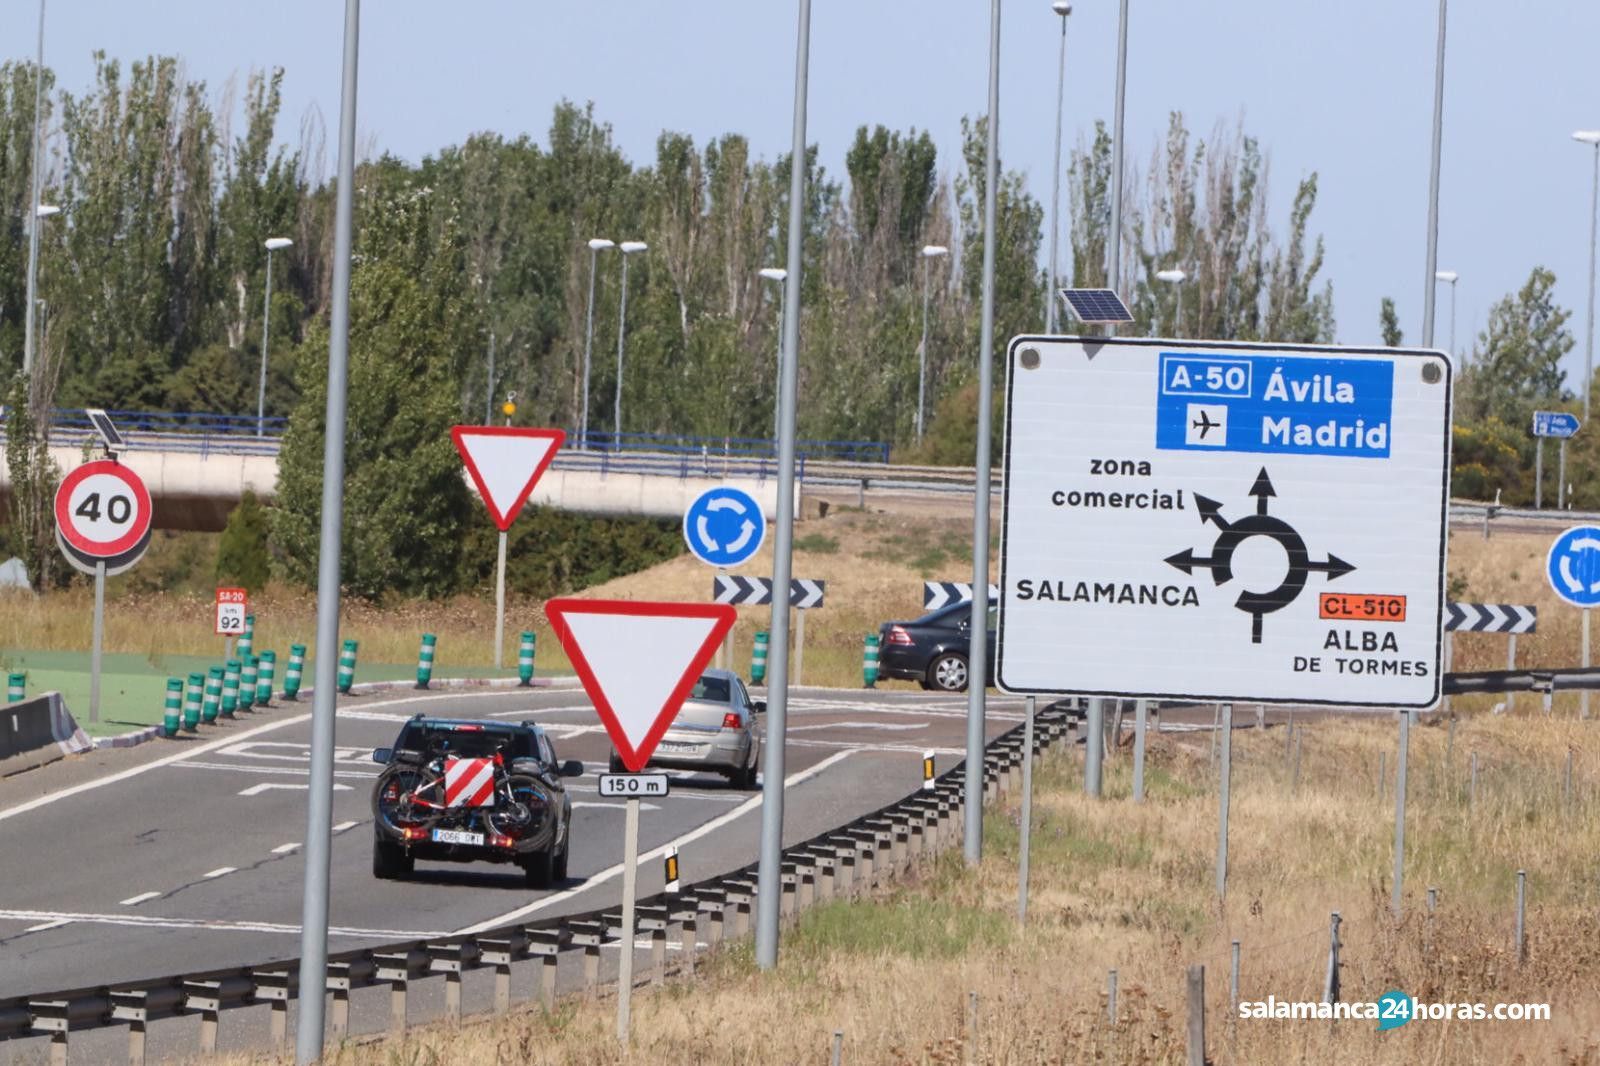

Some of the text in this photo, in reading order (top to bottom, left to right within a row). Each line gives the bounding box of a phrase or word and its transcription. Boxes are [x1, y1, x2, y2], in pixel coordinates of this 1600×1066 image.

[1170, 366, 1245, 390] A-50
[1264, 367, 1355, 403] Ávila
[1262, 417, 1387, 448] Madrid
[1090, 459, 1152, 476] zona
[76, 493, 131, 524] 40
[1052, 489, 1184, 510] comercial
[1016, 580, 1199, 606] SALAMANCA
[1324, 598, 1401, 617] CL-510
[221, 616, 240, 629] 92
[1323, 631, 1398, 652] ALBA
[1294, 657, 1428, 676] DE TORMES
[608, 779, 659, 792] 150 m
